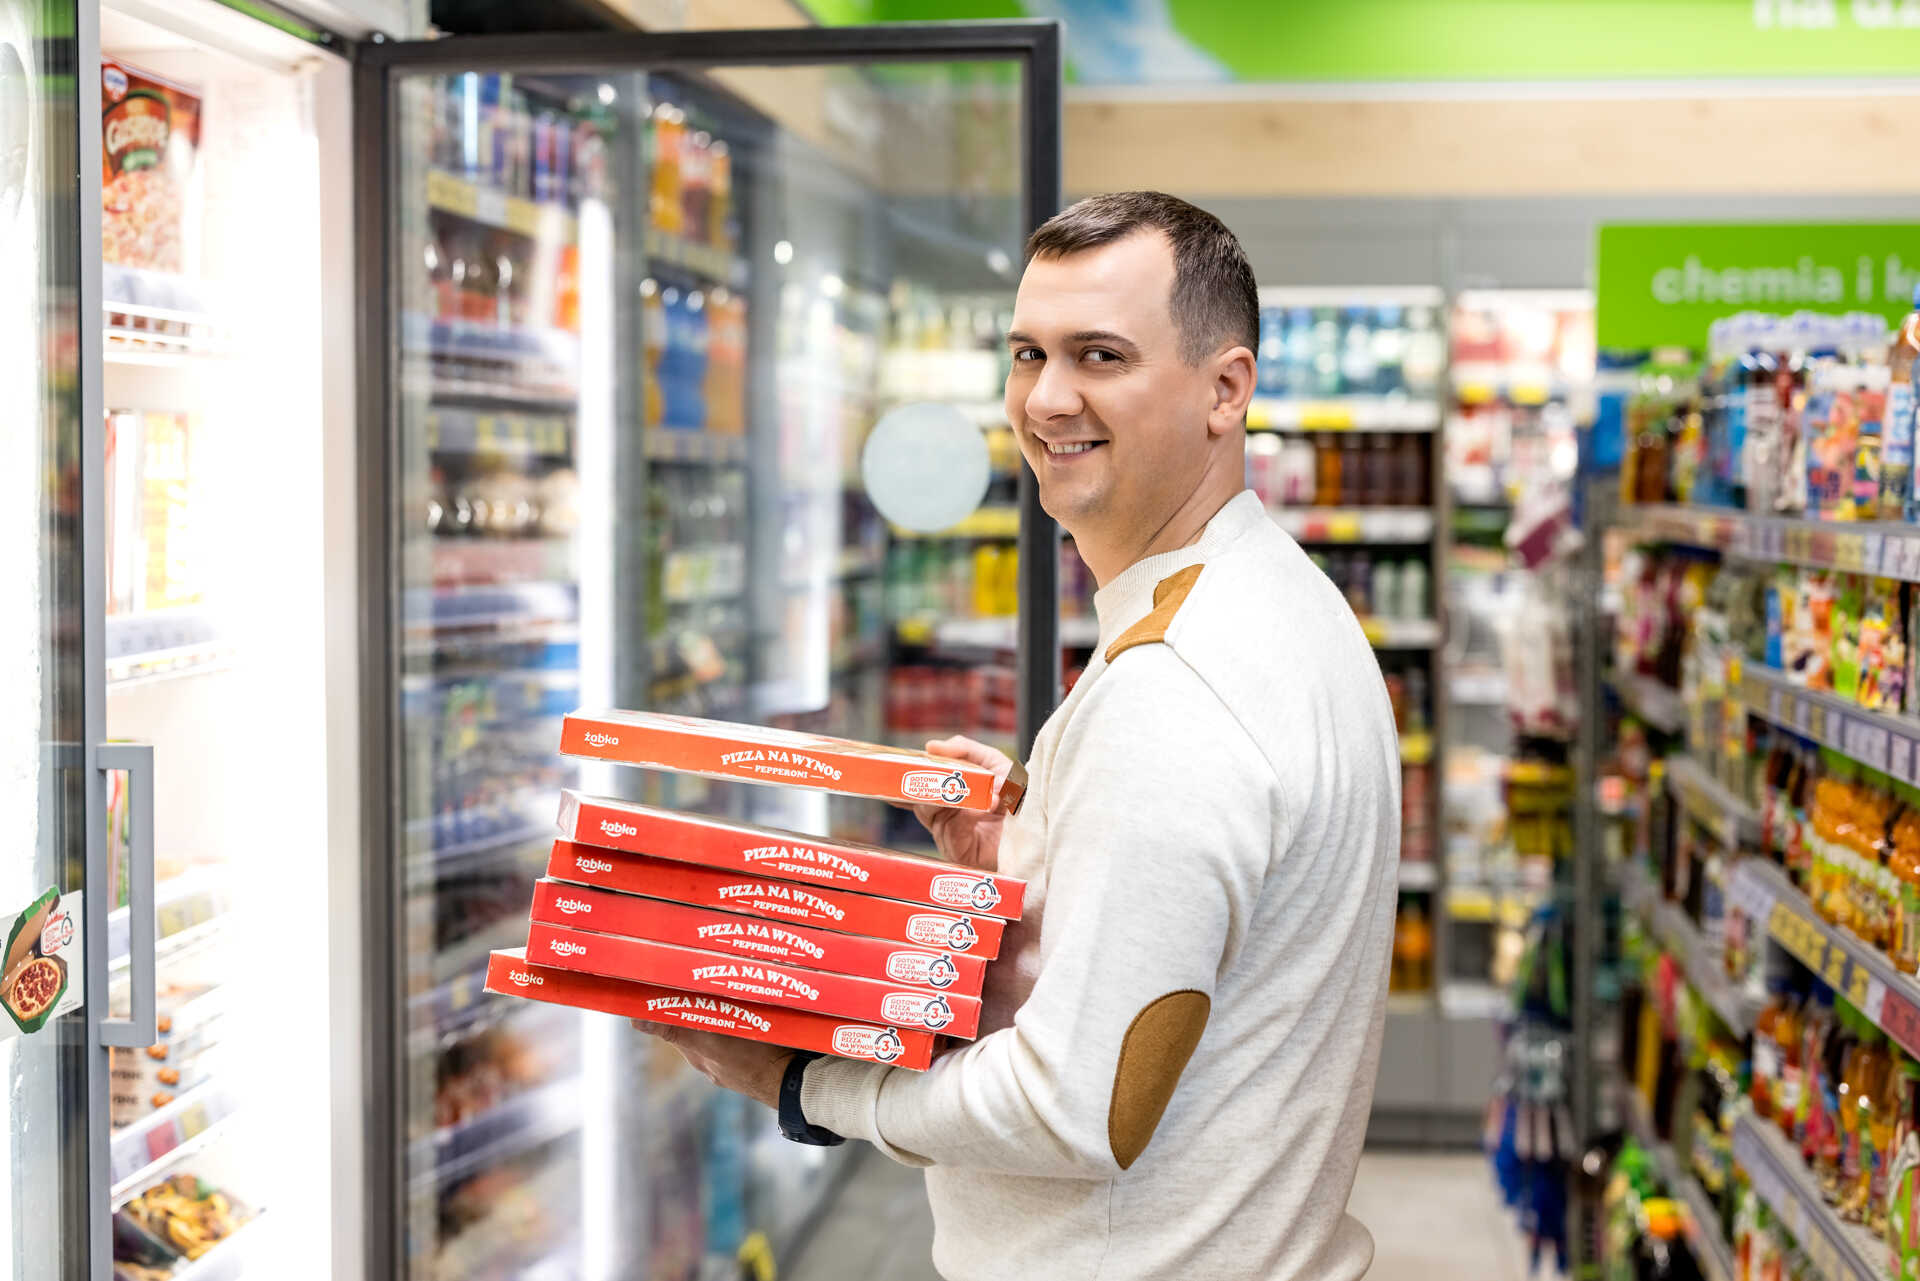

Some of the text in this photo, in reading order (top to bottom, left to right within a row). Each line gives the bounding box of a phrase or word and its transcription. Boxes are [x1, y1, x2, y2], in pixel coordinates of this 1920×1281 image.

[1652, 253, 1844, 304] chemia
[1856, 253, 1874, 304] i
[584, 732, 619, 745] żabka
[720, 750, 842, 781] PIZZA NA WYNOS
[755, 765, 808, 778] PEPPERONI
[948, 783, 956, 794] 3
[600, 820, 637, 836] żabka
[576, 856, 612, 872] żabka
[743, 846, 870, 882] PIZZA NA WYNOS
[778, 862, 834, 879] PEPPERONI
[718, 884, 845, 920] PIZZA NA WYNOS
[979, 889, 986, 900] 3
[555, 897, 592, 912] żabka
[753, 900, 808, 917] PEPPERONI
[697, 924, 824, 959] PIZZA NA WYNOS
[956, 930, 963, 940] 3
[550, 939, 586, 955] żabka
[732, 939, 788, 956] PEPPERONI
[509, 970, 544, 985] żabka
[936, 966, 944, 978] 3
[692, 966, 820, 1000] PIZZA NA WYNOS
[727, 981, 784, 998] PEPPERONI
[646, 997, 771, 1032] PIZZA NA WYNOS
[681, 1012, 736, 1028] PEPPERONI
[931, 1008, 938, 1019] 3
[882, 1041, 889, 1052] 3
